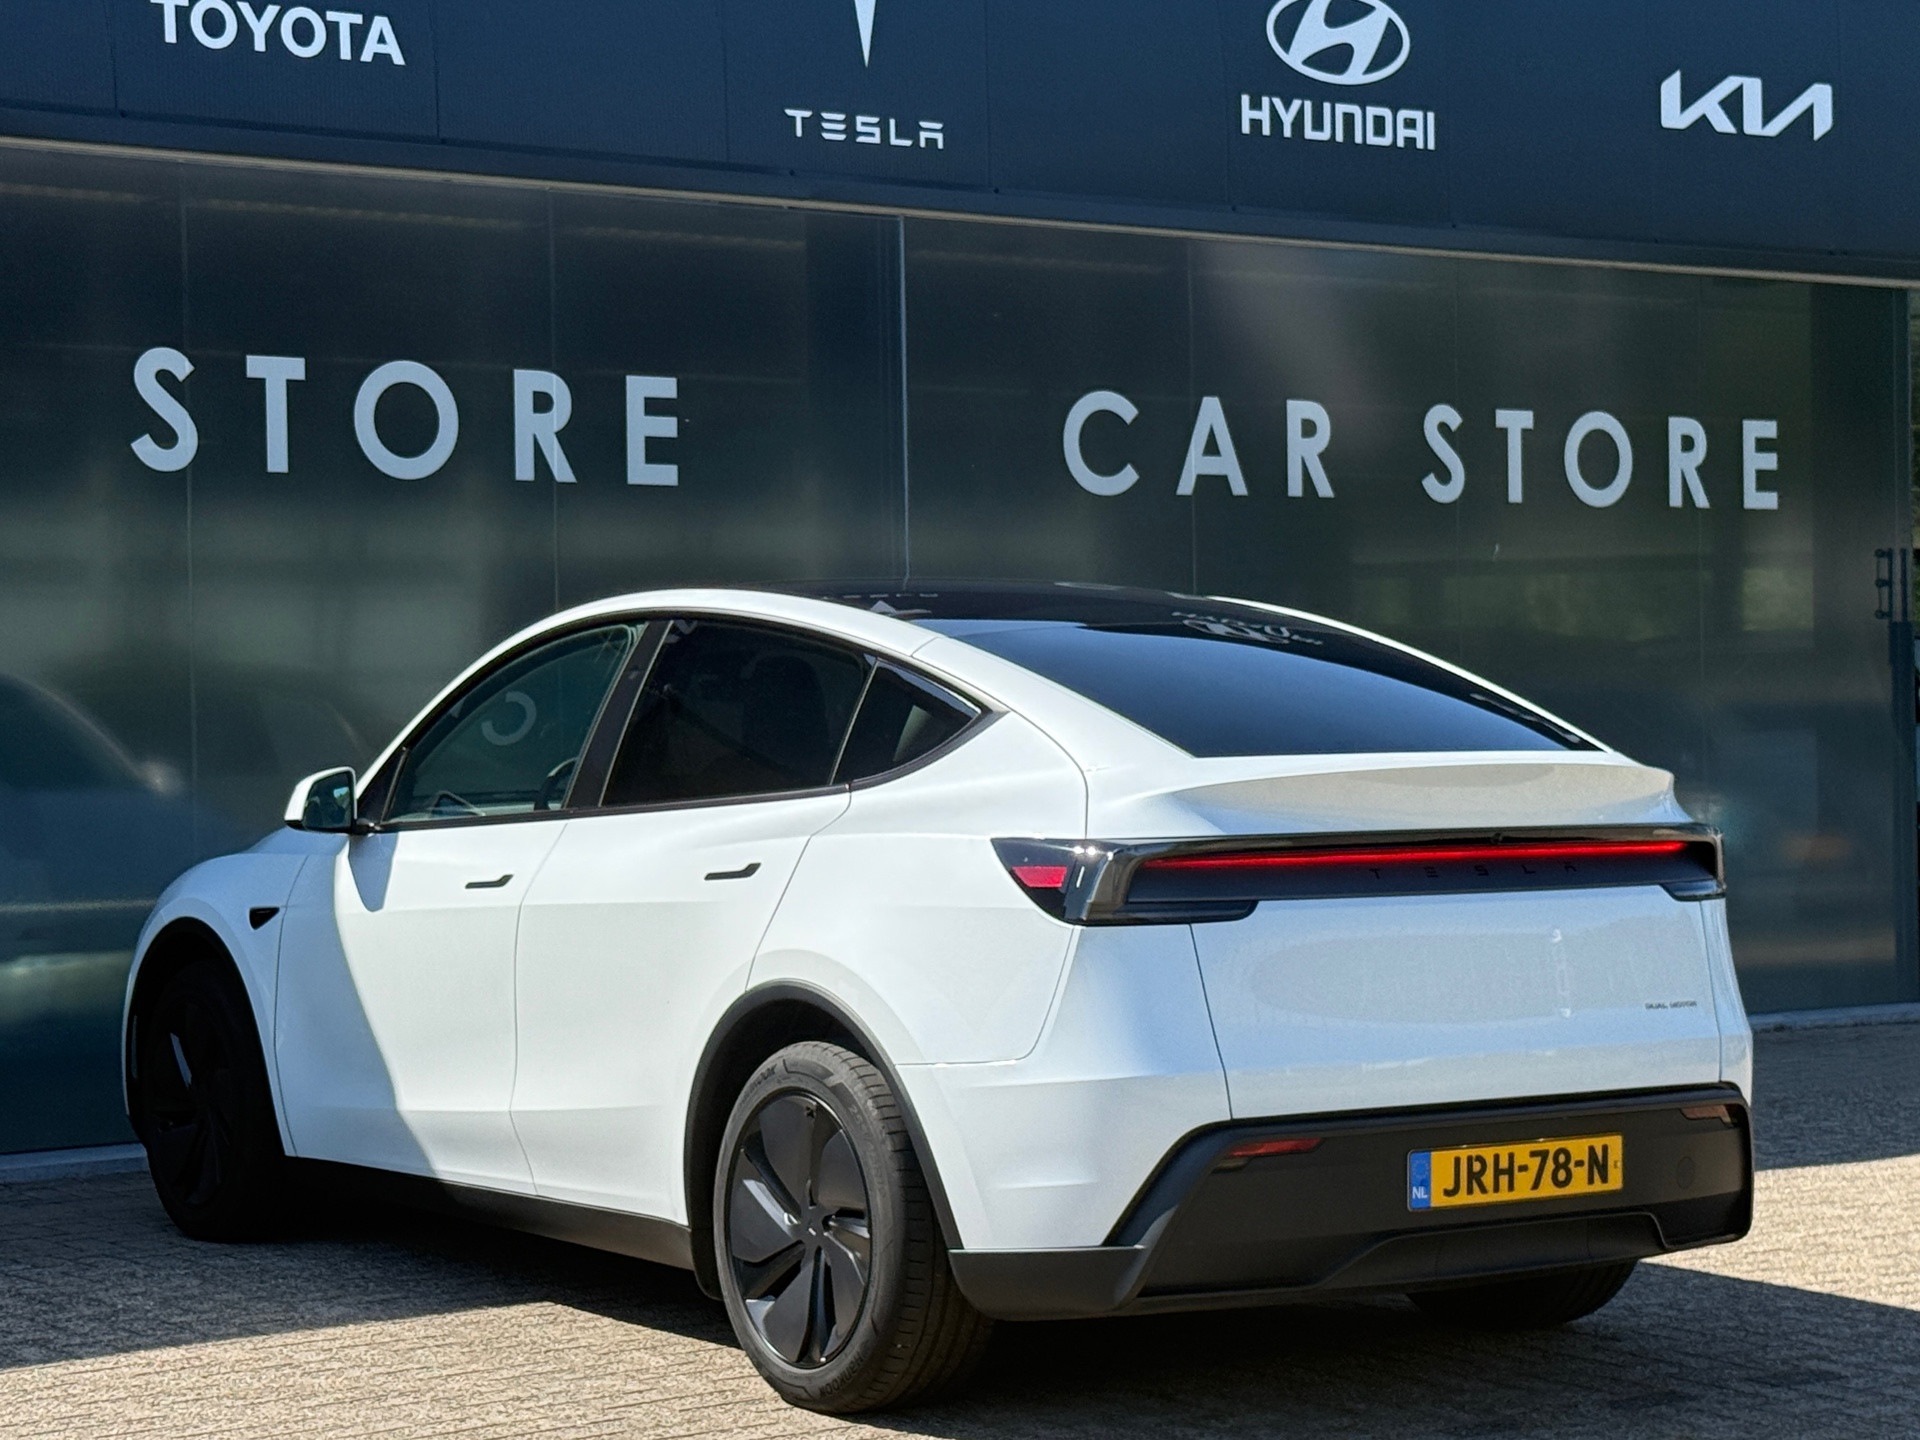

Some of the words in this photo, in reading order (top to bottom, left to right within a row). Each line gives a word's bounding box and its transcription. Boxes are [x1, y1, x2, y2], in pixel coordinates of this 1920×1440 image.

[150, 0, 406, 66] TOYOTA
[784, 108, 944, 150] TESLA
[1240, 93, 1435, 151] HYUNDAI
[1660, 69, 1833, 141] KIA
[130, 346, 679, 486] STORE
[1062, 390, 1334, 498] CAR
[1422, 404, 1778, 510] STORE
[1368, 861, 1577, 880] TESLA
[1411, 1186, 1428, 1199] NL
[1442, 1143, 1609, 1197] JRH-78-N
